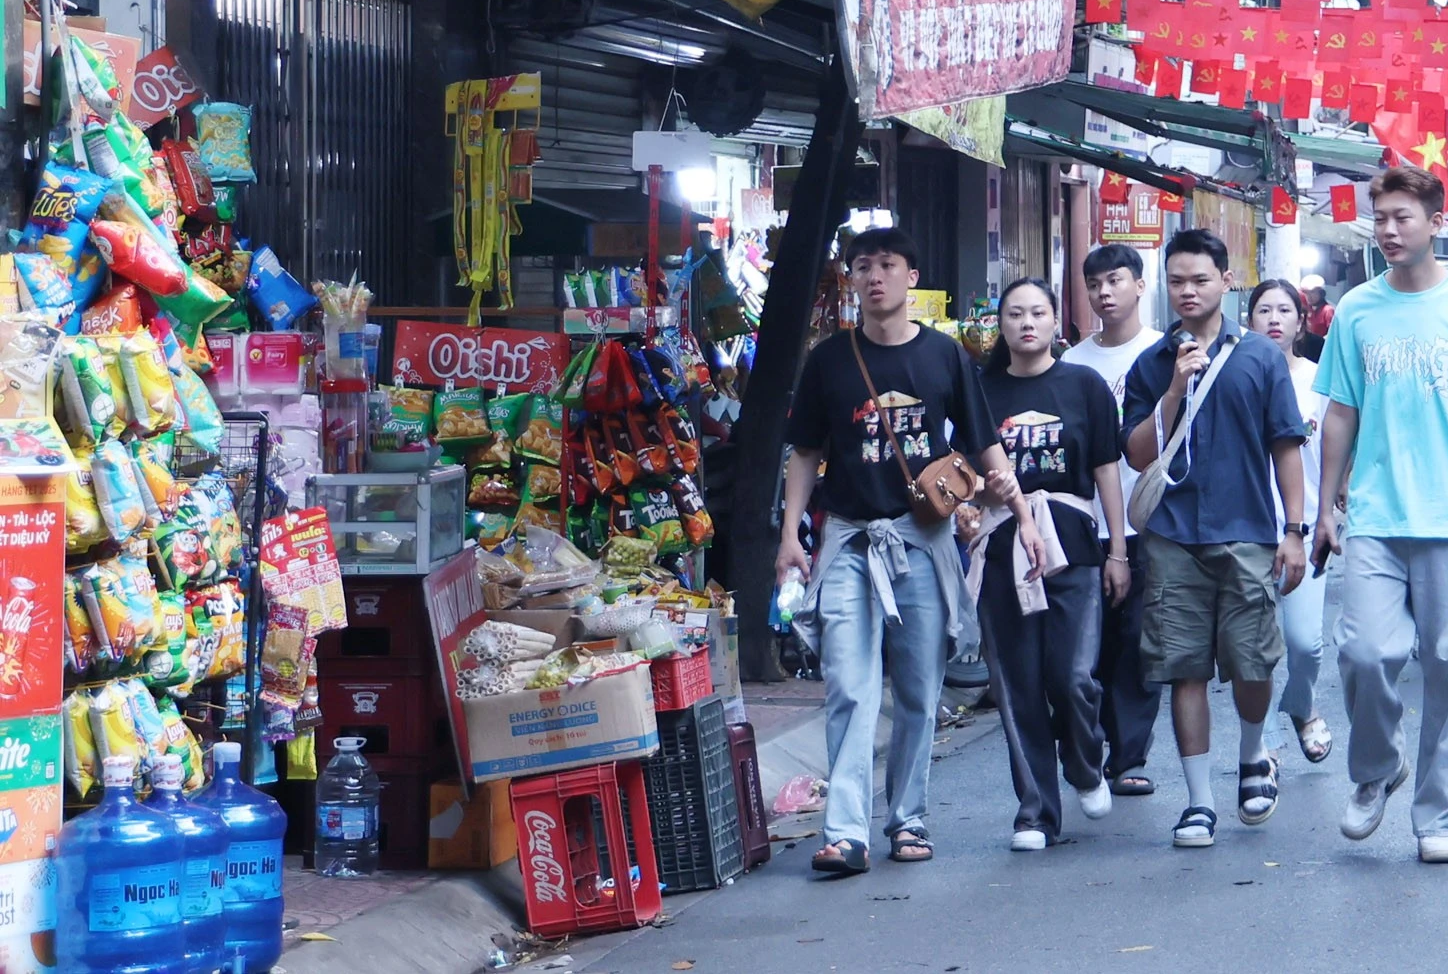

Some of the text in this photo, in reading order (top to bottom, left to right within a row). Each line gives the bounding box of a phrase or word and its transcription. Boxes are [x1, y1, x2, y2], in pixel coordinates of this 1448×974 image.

[429, 332, 532, 384] Oishi
[13, 510, 28, 526] TÀI
[36, 510, 56, 528] LỘC
[10, 530, 35, 548] DIỆU
[36, 530, 51, 544] KỲ
[509, 707, 555, 725] ENERGY
[123, 882, 165, 905] Ngọc
